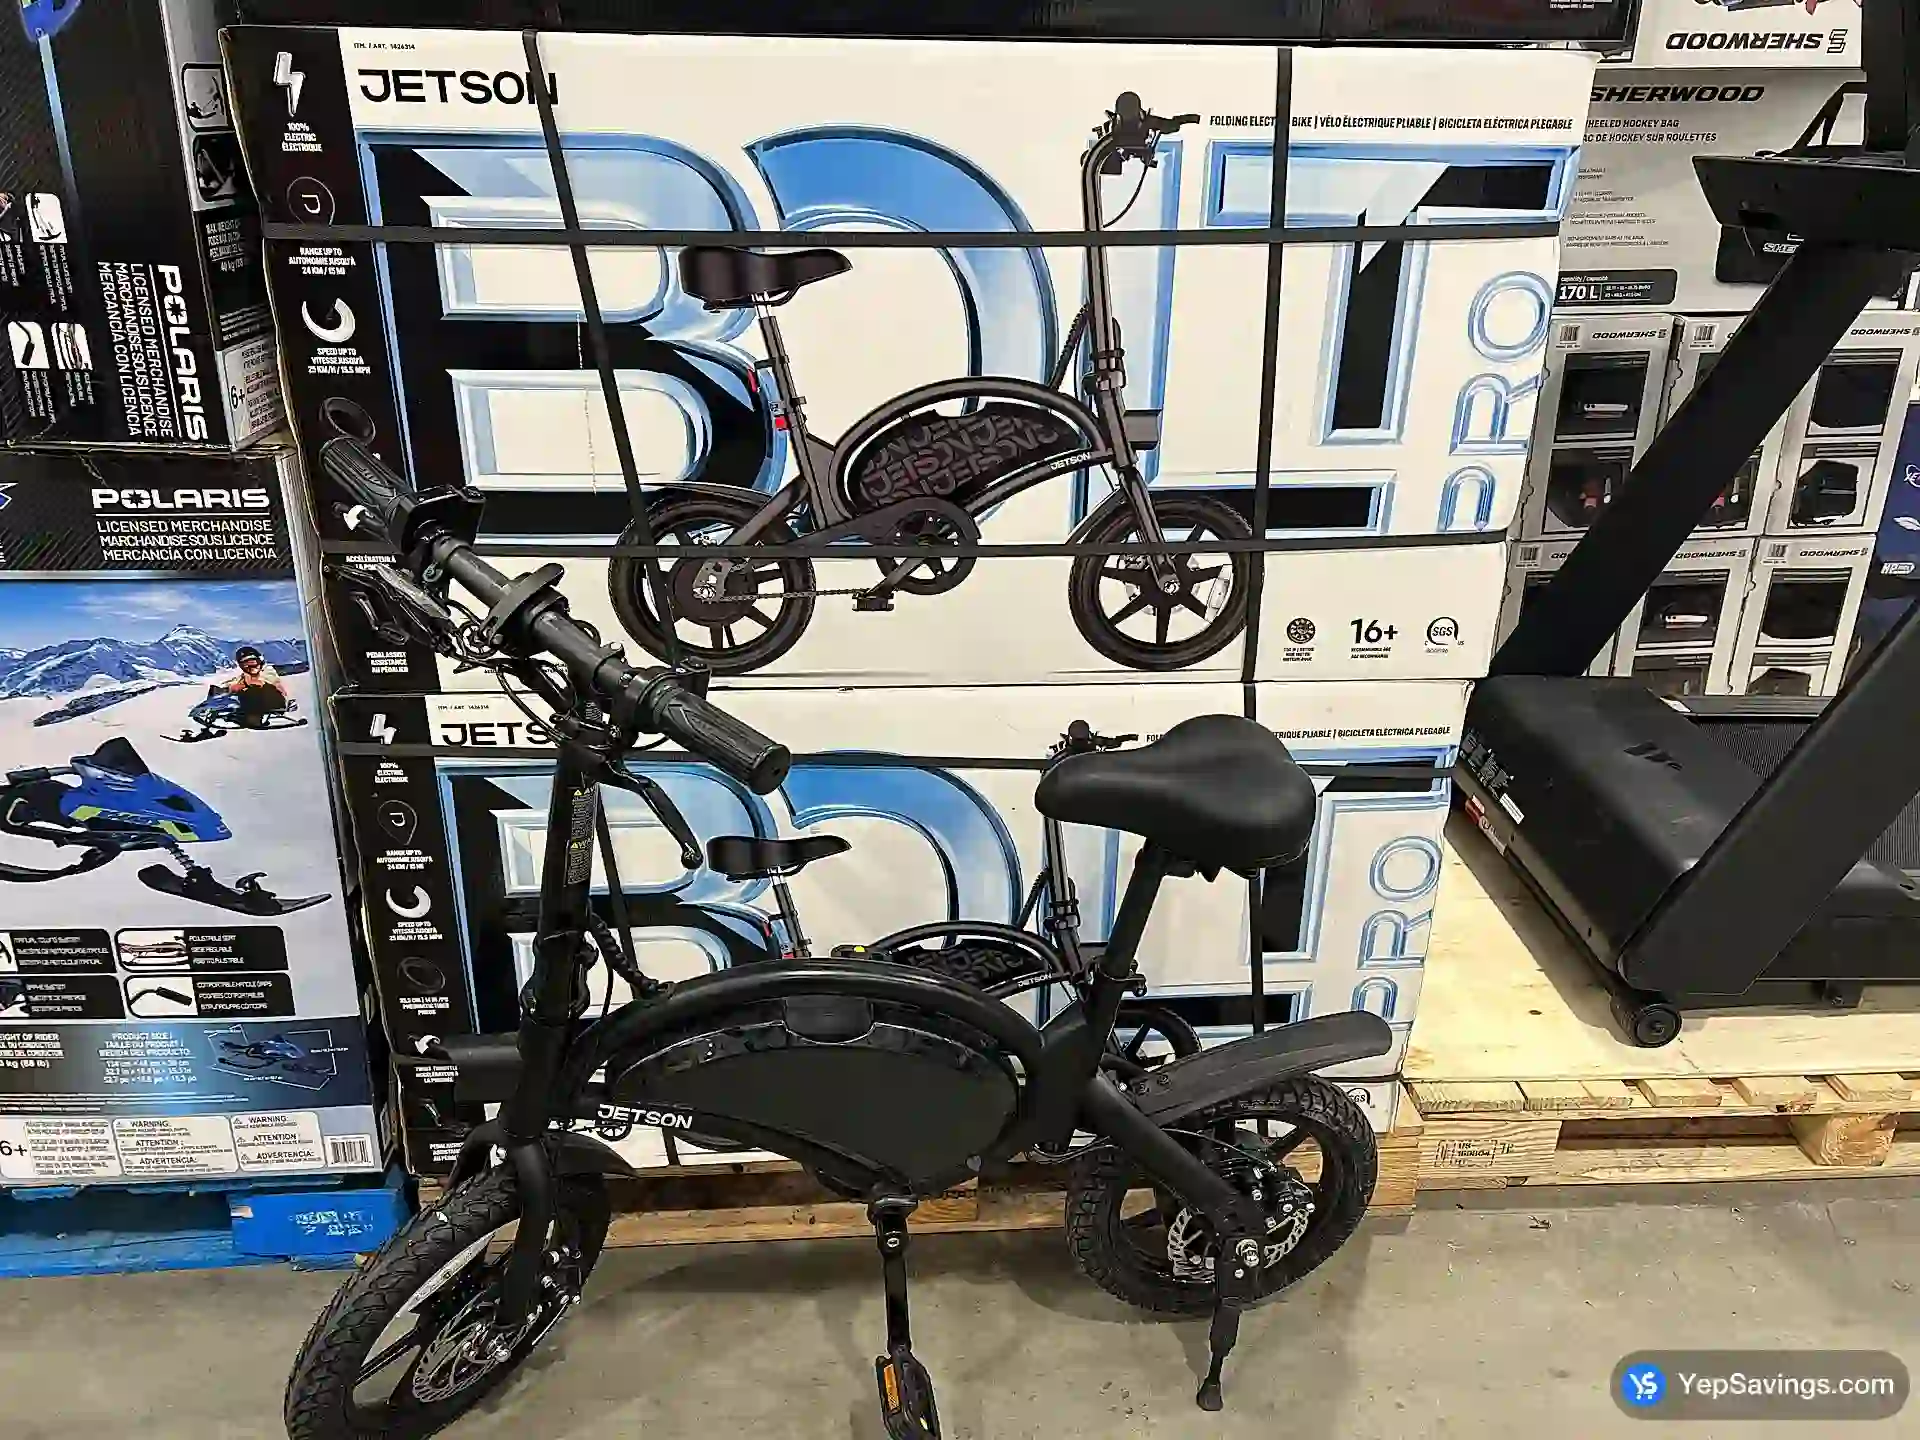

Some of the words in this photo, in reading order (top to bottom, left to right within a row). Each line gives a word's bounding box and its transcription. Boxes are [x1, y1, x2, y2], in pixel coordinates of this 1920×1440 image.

[1665, 33, 1824, 50] SHERWOOD
[357, 68, 559, 105] JETSON
[1590, 86, 1766, 102] SHERWOOD
[287, 122, 309, 132] 100%
[1209, 115, 1248, 127] FOLDING
[1249, 115, 1277, 127] ELECT
[1291, 116, 1313, 128] BIKE
[1319, 114, 1342, 128] VÉLO
[1342, 114, 1396, 129] ÉLECTRIQUE
[1396, 117, 1432, 129] PLIABLE
[1438, 118, 1482, 129] BICICLETA
[1483, 116, 1529, 129] ELÉCTRICA
[1530, 118, 1573, 130] PLEGABLE
[1585, 119, 1622, 128] HEELED
[1622, 119, 1660, 128] HOCKEY
[1660, 119, 1680, 128] BAG
[283, 132, 316, 142] ELECTRIC
[1583, 133, 1594, 142] AC
[1595, 133, 1608, 142] DE
[1609, 133, 1645, 143] HOCKEY
[1646, 133, 1664, 142] SUR
[1666, 132, 1717, 142] ROULETTES
[332, 247, 343, 256] TO
[1558, 285, 1587, 300] 170
[1589, 285, 1598, 299] L
[98, 261, 126, 343] MERCANCÍA
[114, 262, 143, 352] MARCHANDISE
[1591, 330, 1657, 339] SHERWOOD
[130, 263, 156, 336] LICENSED
[144, 338, 174, 438] MERCHANDISE
[157, 264, 209, 441] POLARIS
[316, 347, 337, 356] SPEED
[337, 347, 347, 356] UP
[346, 347, 357, 356] TO
[113, 344, 130, 373] CON
[131, 352, 149, 386] SOUS
[119, 374, 142, 436] LICENCIA
[1437, 270, 1553, 534] PRO
[136, 385, 158, 437] LICENCE
[1051, 452, 1092, 470] JETSON
[91, 487, 270, 509] POLARIS
[97, 519, 169, 533] LICENSED
[171, 518, 273, 532] MERCHANDISE
[100, 534, 190, 547] MARCHANDISE
[189, 534, 222, 546] SOUS
[223, 533, 275, 546] LICENCE
[103, 546, 182, 562] MERCANCÍA
[184, 549, 214, 561] CON
[215, 546, 278, 560] LICENCIA
[1674, 550, 1737, 559] SHERWOOD
[1799, 549, 1861, 557] SHERWOOD
[1350, 618, 1398, 645] 16+
[1431, 626, 1453, 637] SGS
[440, 722, 551, 745] JETS
[1272, 730, 1302, 740] TRIQUE
[1301, 729, 1332, 740] PLIABLE
[1337, 728, 1375, 738] BICICLETA
[1375, 726, 1415, 738] ELÉCTRICA
[1414, 726, 1451, 736] PLEGABLE
[0, 1033, 21, 1041] EIGHT
[22, 1033, 33, 1041] OF
[248, 1115, 290, 1124] WARNING:
[597, 1103, 693, 1130] JETSON
[135, 1139, 179, 1147] ATTENTION
[252, 1133, 297, 1142] ATTENTION
[256, 1150, 315, 1160] ADVERTENCIA:
